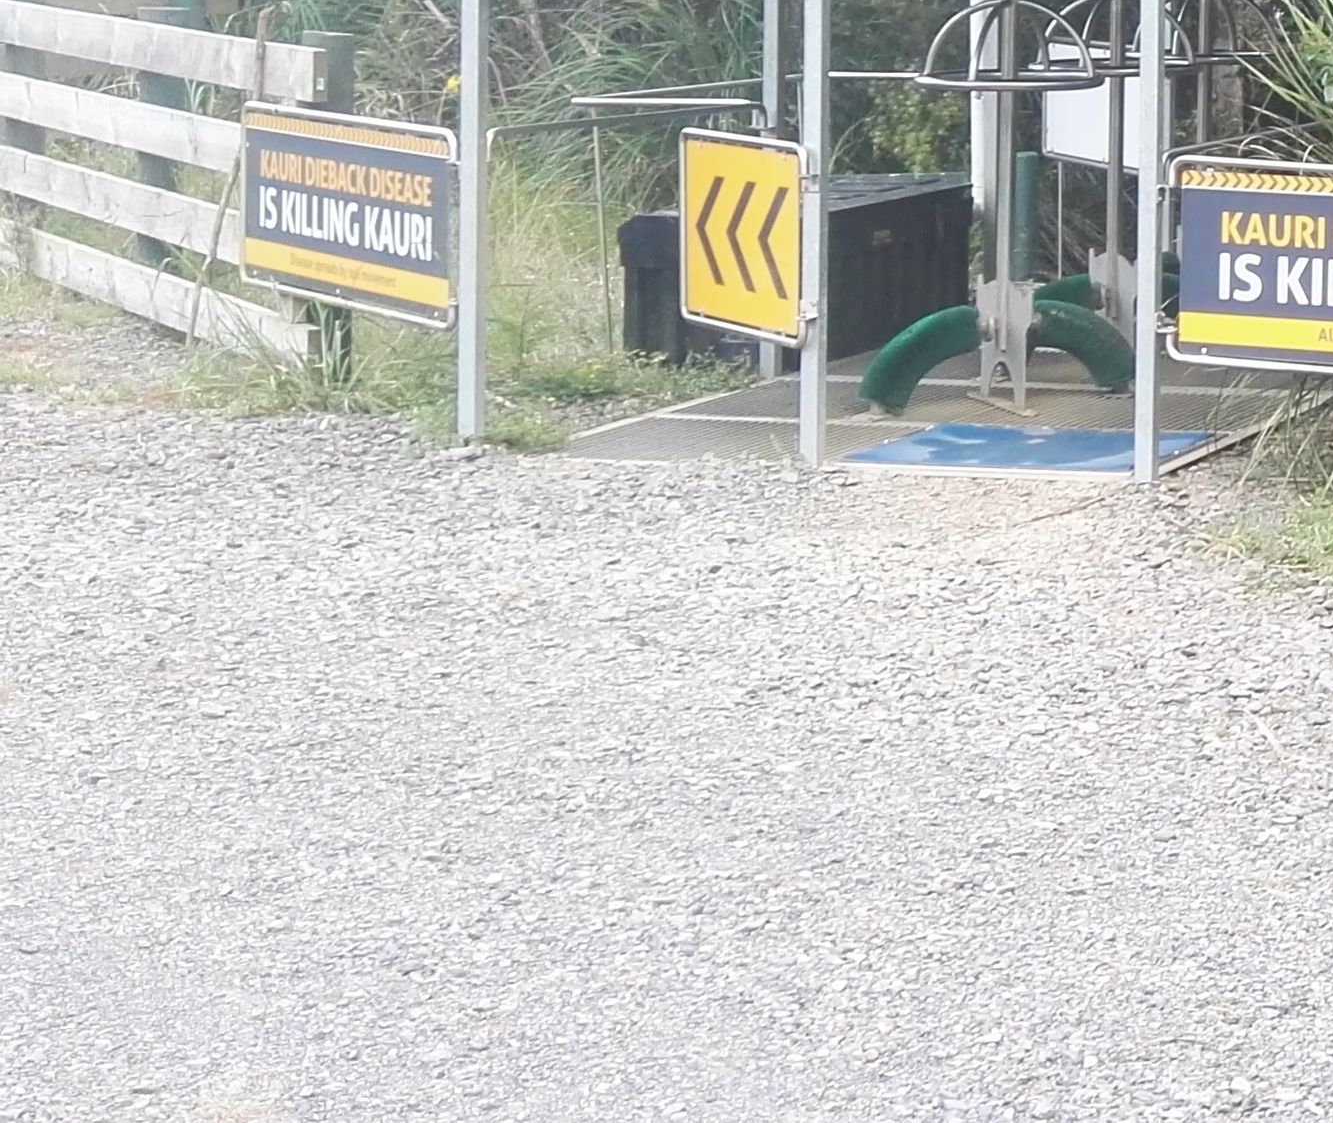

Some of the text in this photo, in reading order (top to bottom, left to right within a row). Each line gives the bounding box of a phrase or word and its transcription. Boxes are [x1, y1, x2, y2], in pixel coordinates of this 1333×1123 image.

[259, 148, 433, 208] KAURI DIEBACK DISEASE
[258, 184, 433, 262] IS KILLING KAURI
[1220, 210, 1326, 249] KAURI
[1218, 251, 1264, 303] IS
